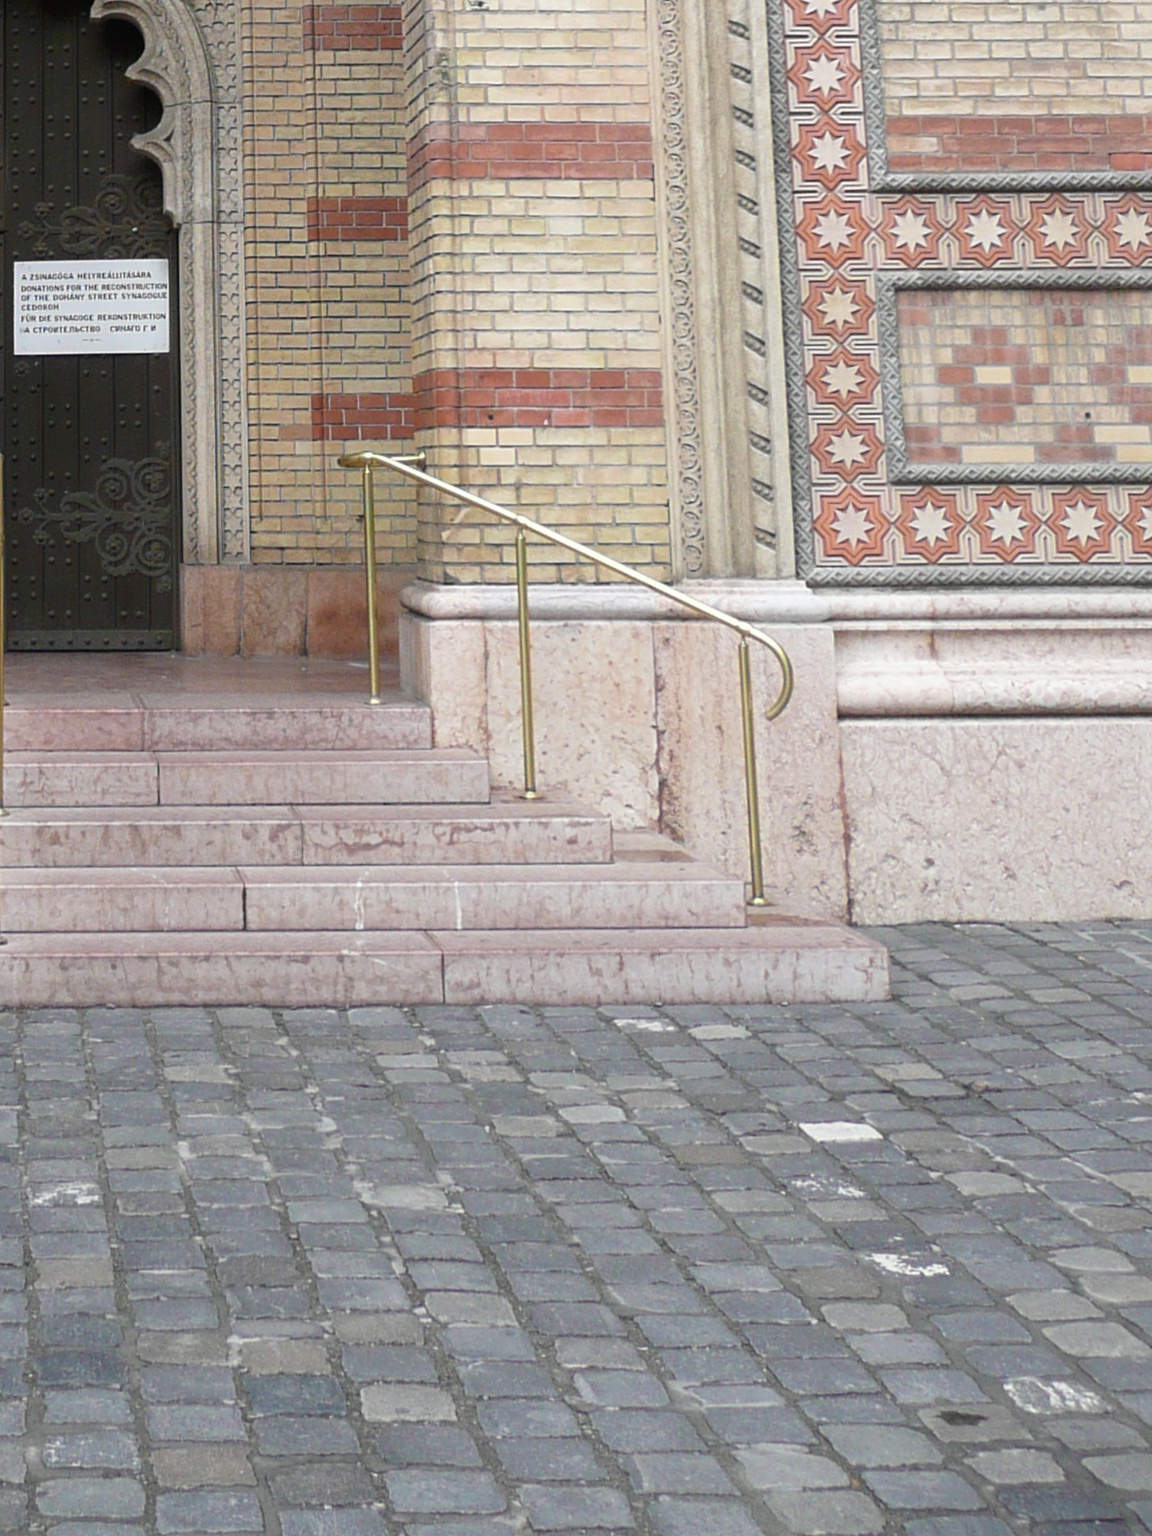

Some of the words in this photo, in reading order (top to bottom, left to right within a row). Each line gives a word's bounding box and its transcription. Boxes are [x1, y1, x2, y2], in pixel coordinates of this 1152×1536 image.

[30, 272, 74, 280] ZSINAGÓGA
[21, 284, 65, 292] DONATIONS
[66, 284, 82, 292] FOR
[101, 282, 168, 291] RECONSTRUCTION
[21, 294, 30, 302] OF
[34, 294, 49, 302] THE
[121, 292, 168, 300] SYNAGOGUE
[20, 314, 36, 322] FÜR
[54, 314, 94, 322] SYNAGOGE
[97, 313, 167, 321] REKONSTRUKTION
